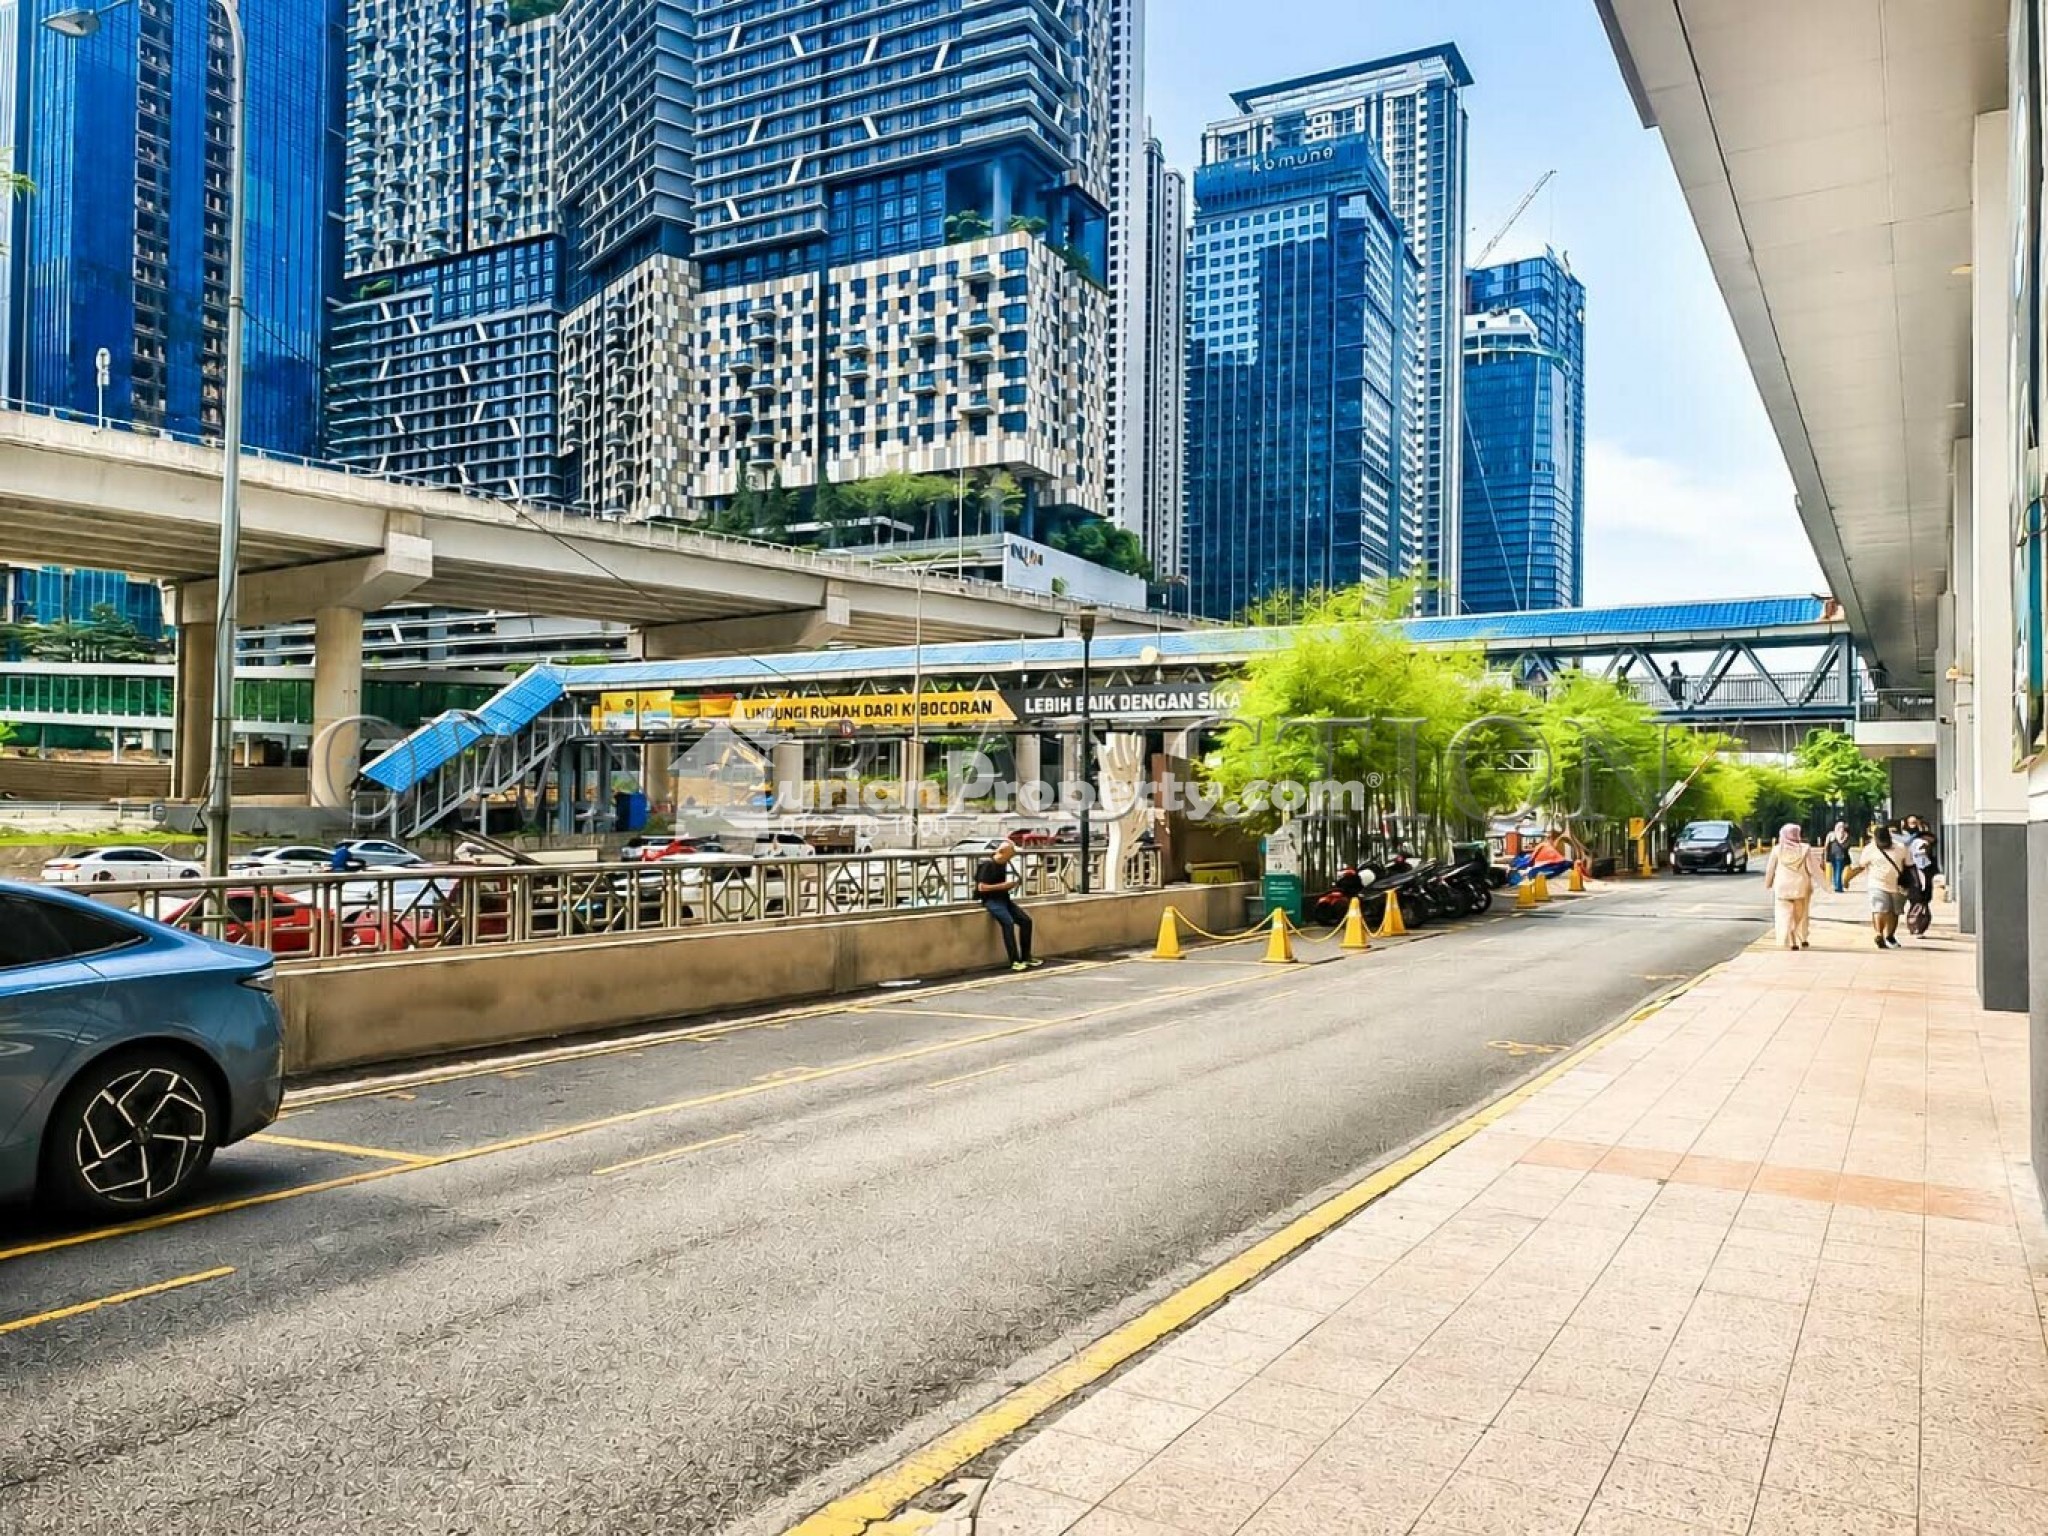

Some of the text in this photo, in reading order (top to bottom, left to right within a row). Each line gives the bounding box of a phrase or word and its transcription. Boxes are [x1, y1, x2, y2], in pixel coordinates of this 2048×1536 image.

[811, 703, 861, 718] RUMAH
[864, 702, 898, 717] DARI
[1025, 697, 1072, 714] LEBIH
[1120, 692, 1193, 711] DENGAN
